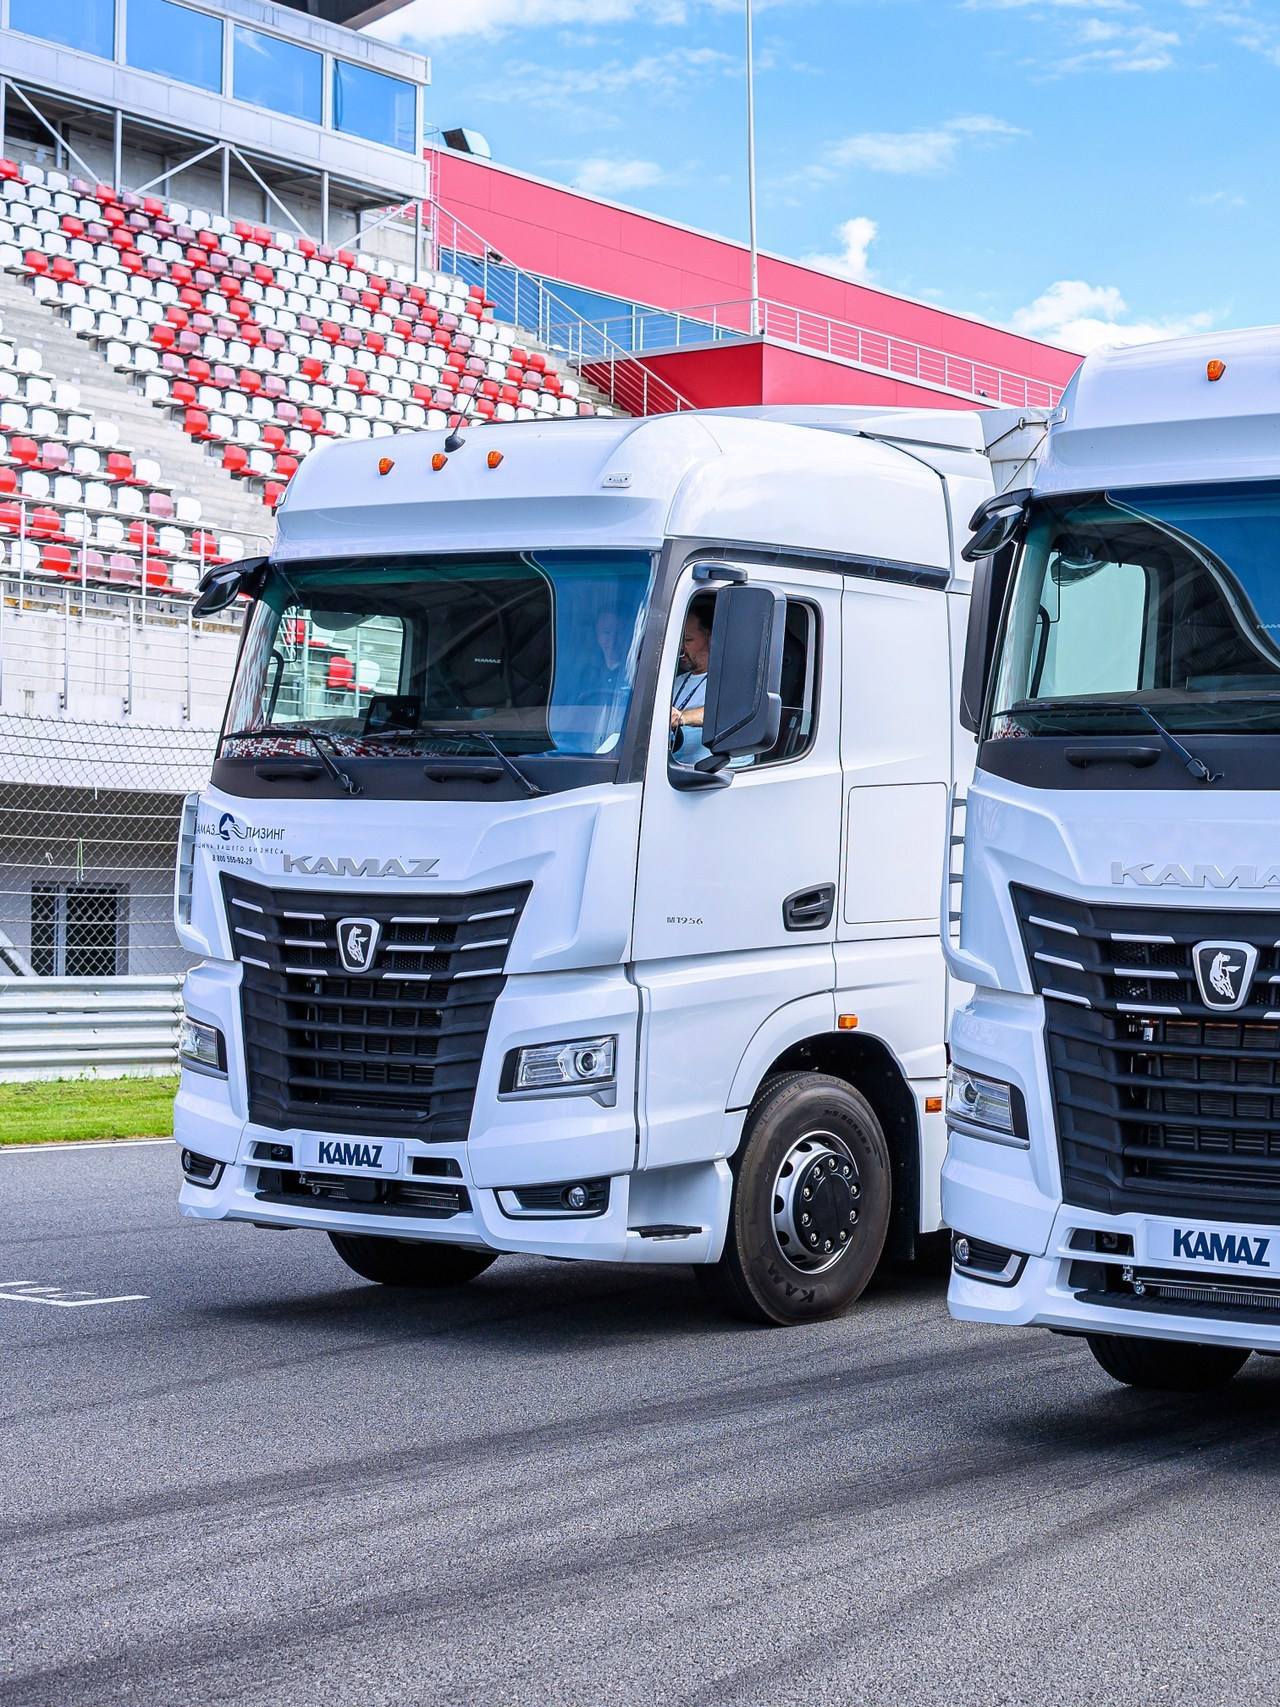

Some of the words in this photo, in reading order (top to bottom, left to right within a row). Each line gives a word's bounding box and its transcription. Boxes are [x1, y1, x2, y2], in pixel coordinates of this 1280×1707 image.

[197, 824, 216, 836] АМАЗ
[245, 826, 286, 841] ЛИЗИНГ
[249, 846, 284, 855] БИЗНЕСА
[283, 854, 440, 878] KAMAZ
[319, 1141, 383, 1168] KAMAZ
[1173, 1229, 1270, 1267] KAMAZ
